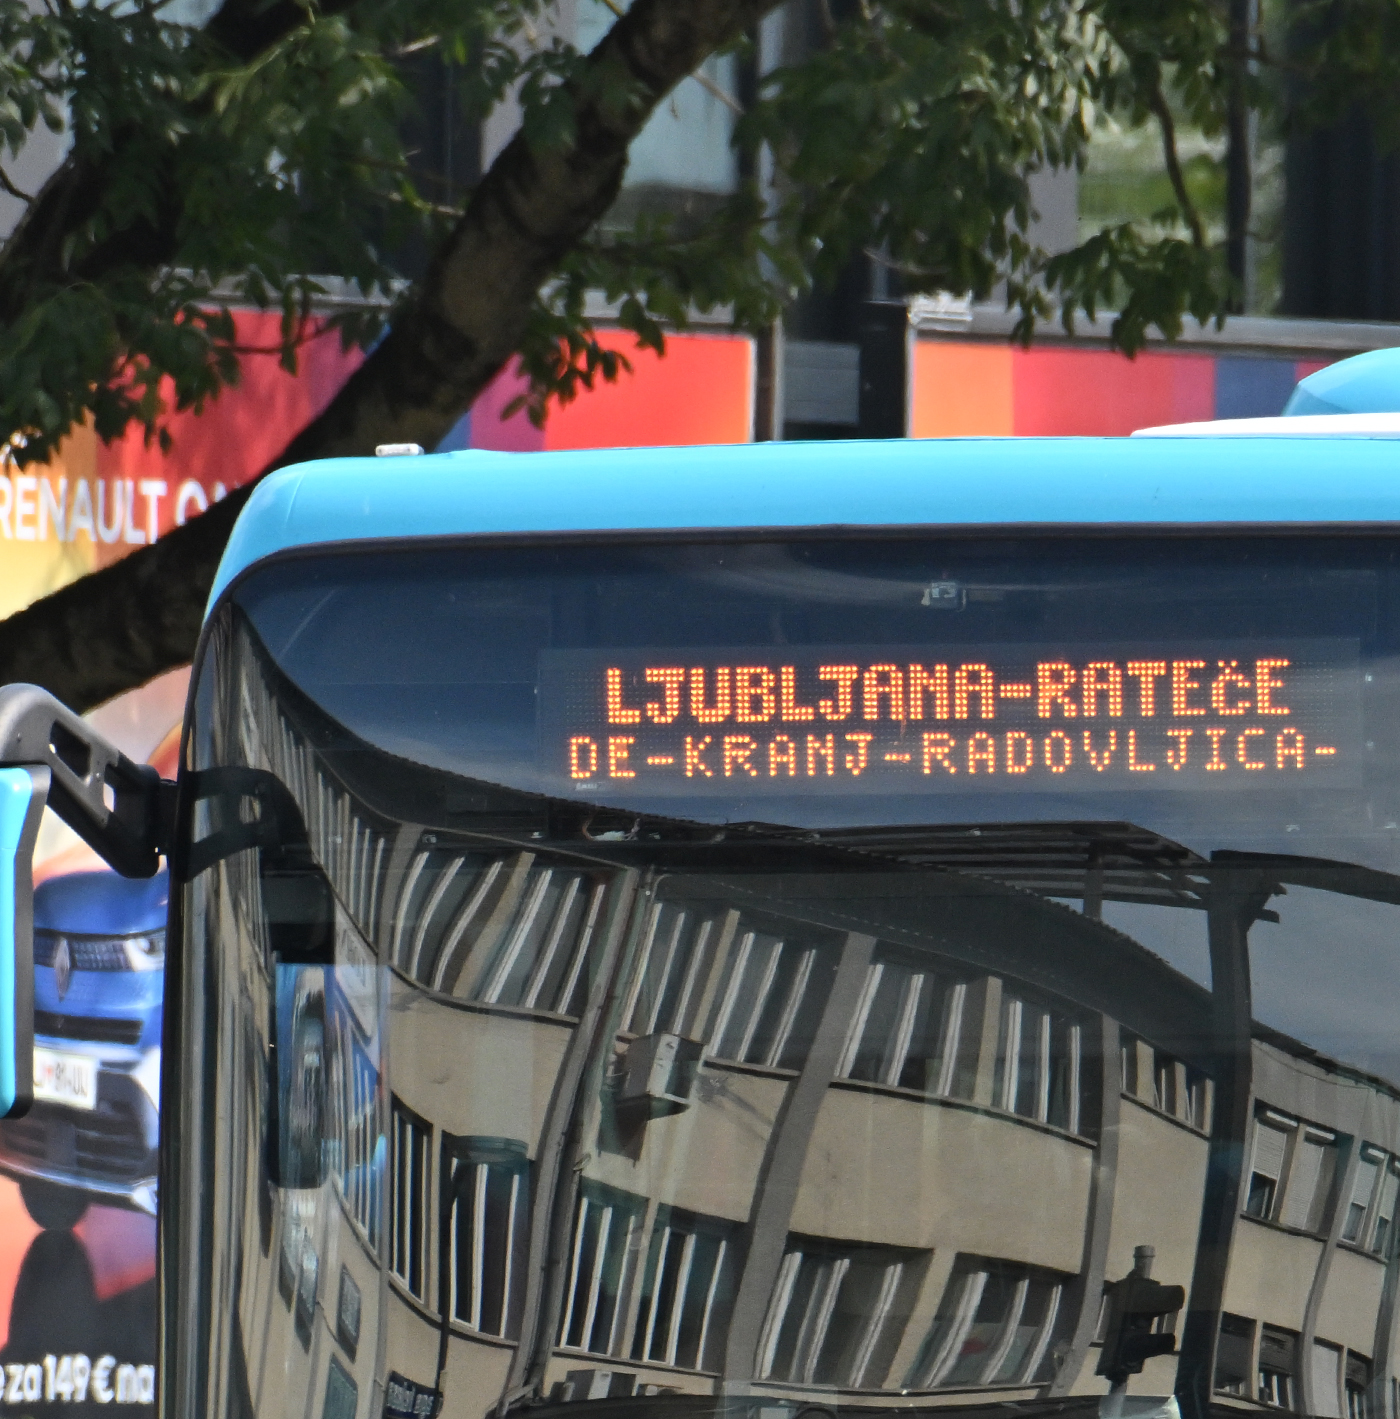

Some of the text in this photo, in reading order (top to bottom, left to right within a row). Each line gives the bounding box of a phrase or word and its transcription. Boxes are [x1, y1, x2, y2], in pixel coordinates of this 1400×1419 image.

[604, 658, 1291, 726] LJUBLJANA-RATEČE
[568, 727, 1337, 781] DE-KRANJ-RADOVLJICA-
[5, 1364, 42, 1403] za
[43, 1353, 92, 1403] 149
[91, 1354, 116, 1403] €
